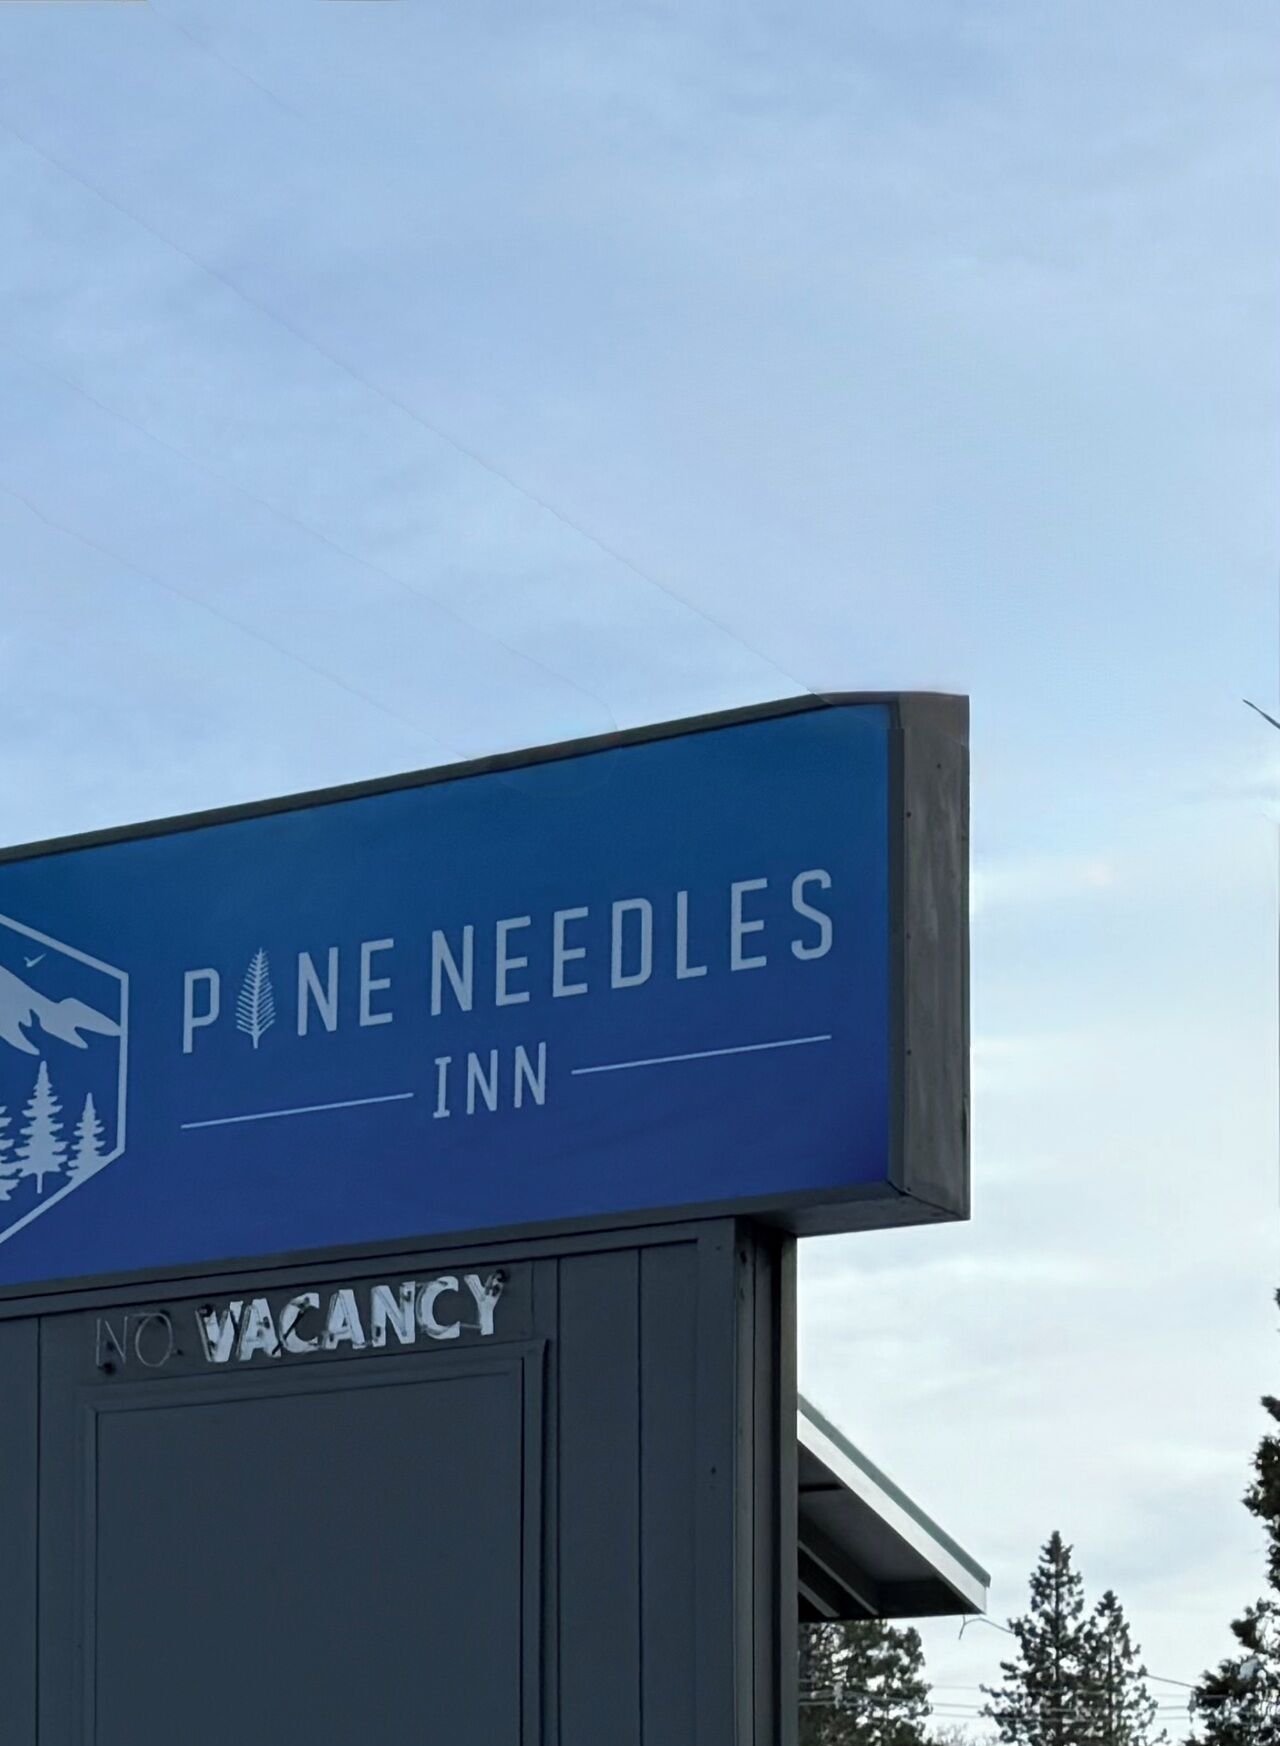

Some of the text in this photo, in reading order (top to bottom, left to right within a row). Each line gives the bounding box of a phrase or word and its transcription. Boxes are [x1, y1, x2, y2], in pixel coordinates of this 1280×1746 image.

[430, 868, 833, 1017] NEEDLES
[432, 1041, 547, 1119] INN
[95, 1271, 506, 1368] NO VACANCY
